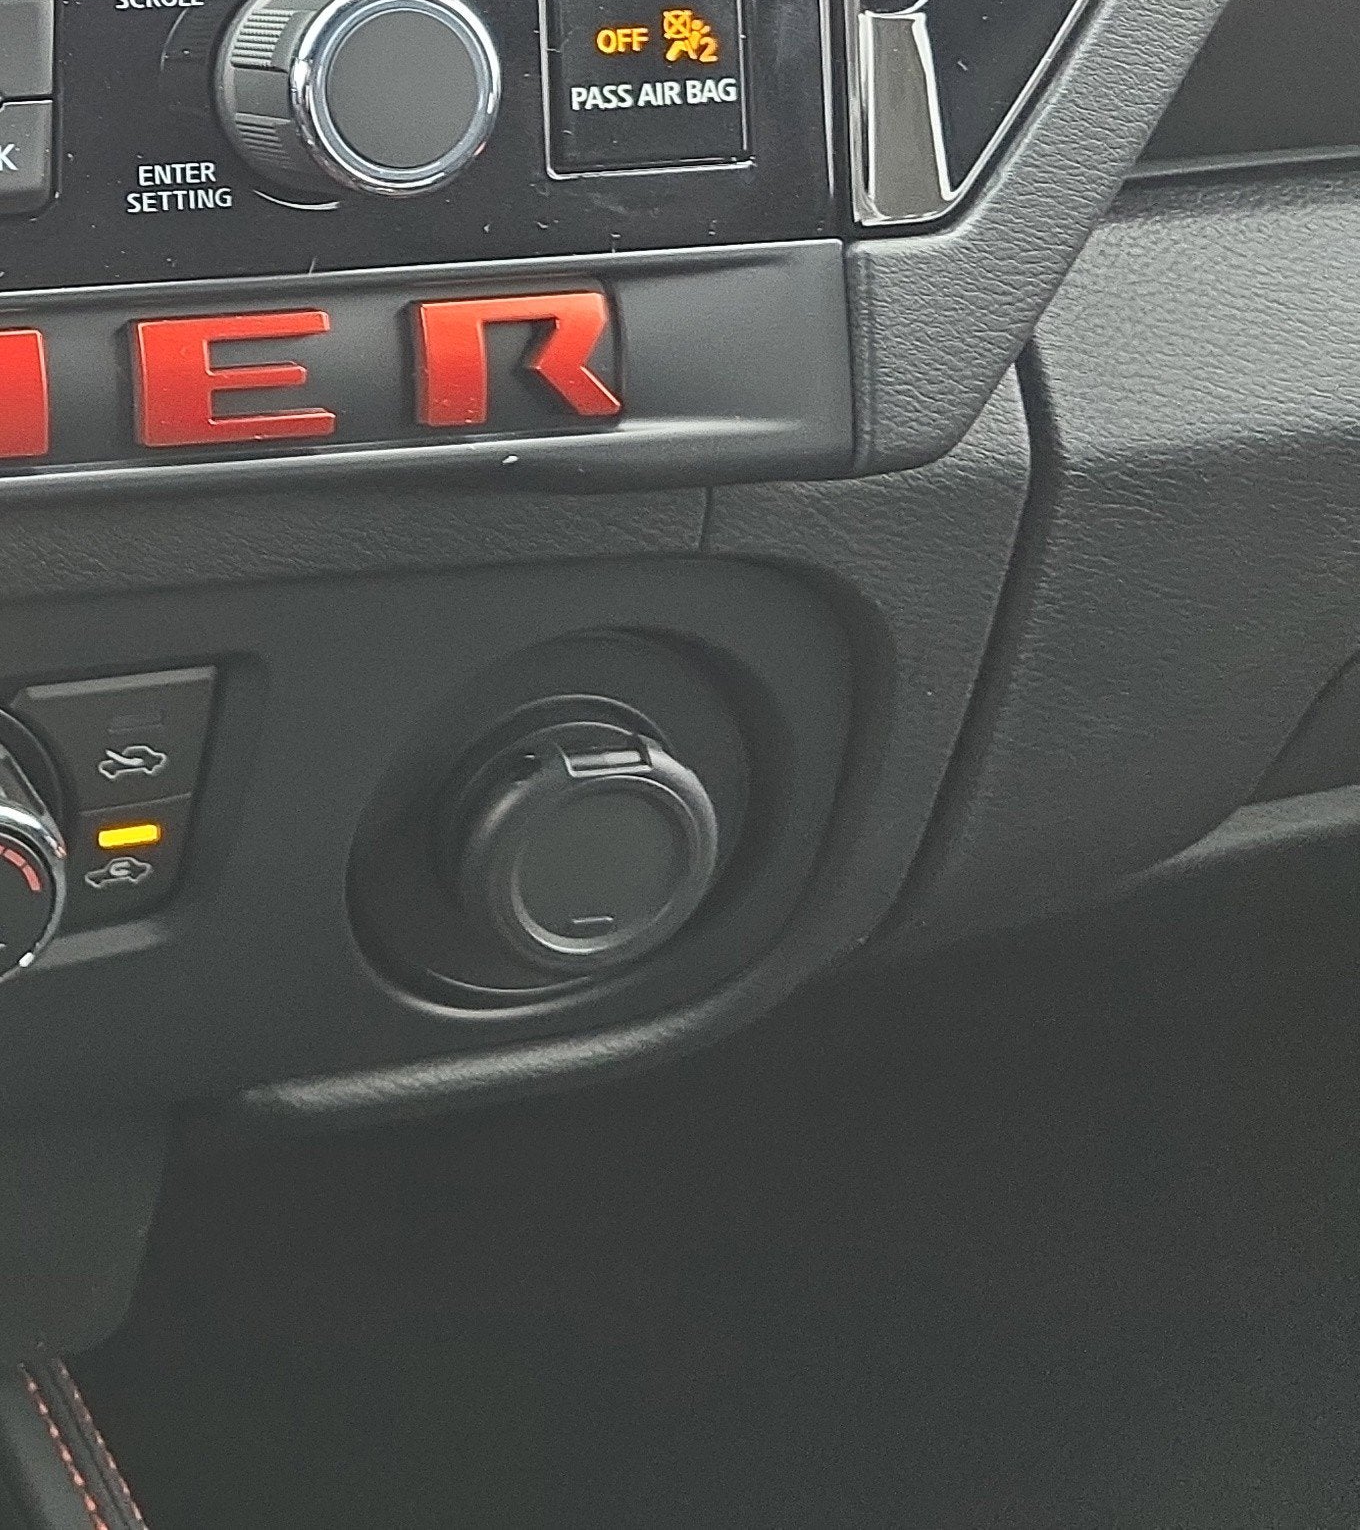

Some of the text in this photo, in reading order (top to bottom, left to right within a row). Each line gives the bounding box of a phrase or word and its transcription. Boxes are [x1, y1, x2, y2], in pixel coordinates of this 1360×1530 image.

[596, 27, 648, 54] OFF
[570, 78, 737, 111] PASS AIR BAG
[137, 162, 216, 186] ENTER
[126, 187, 232, 214] SETTING
